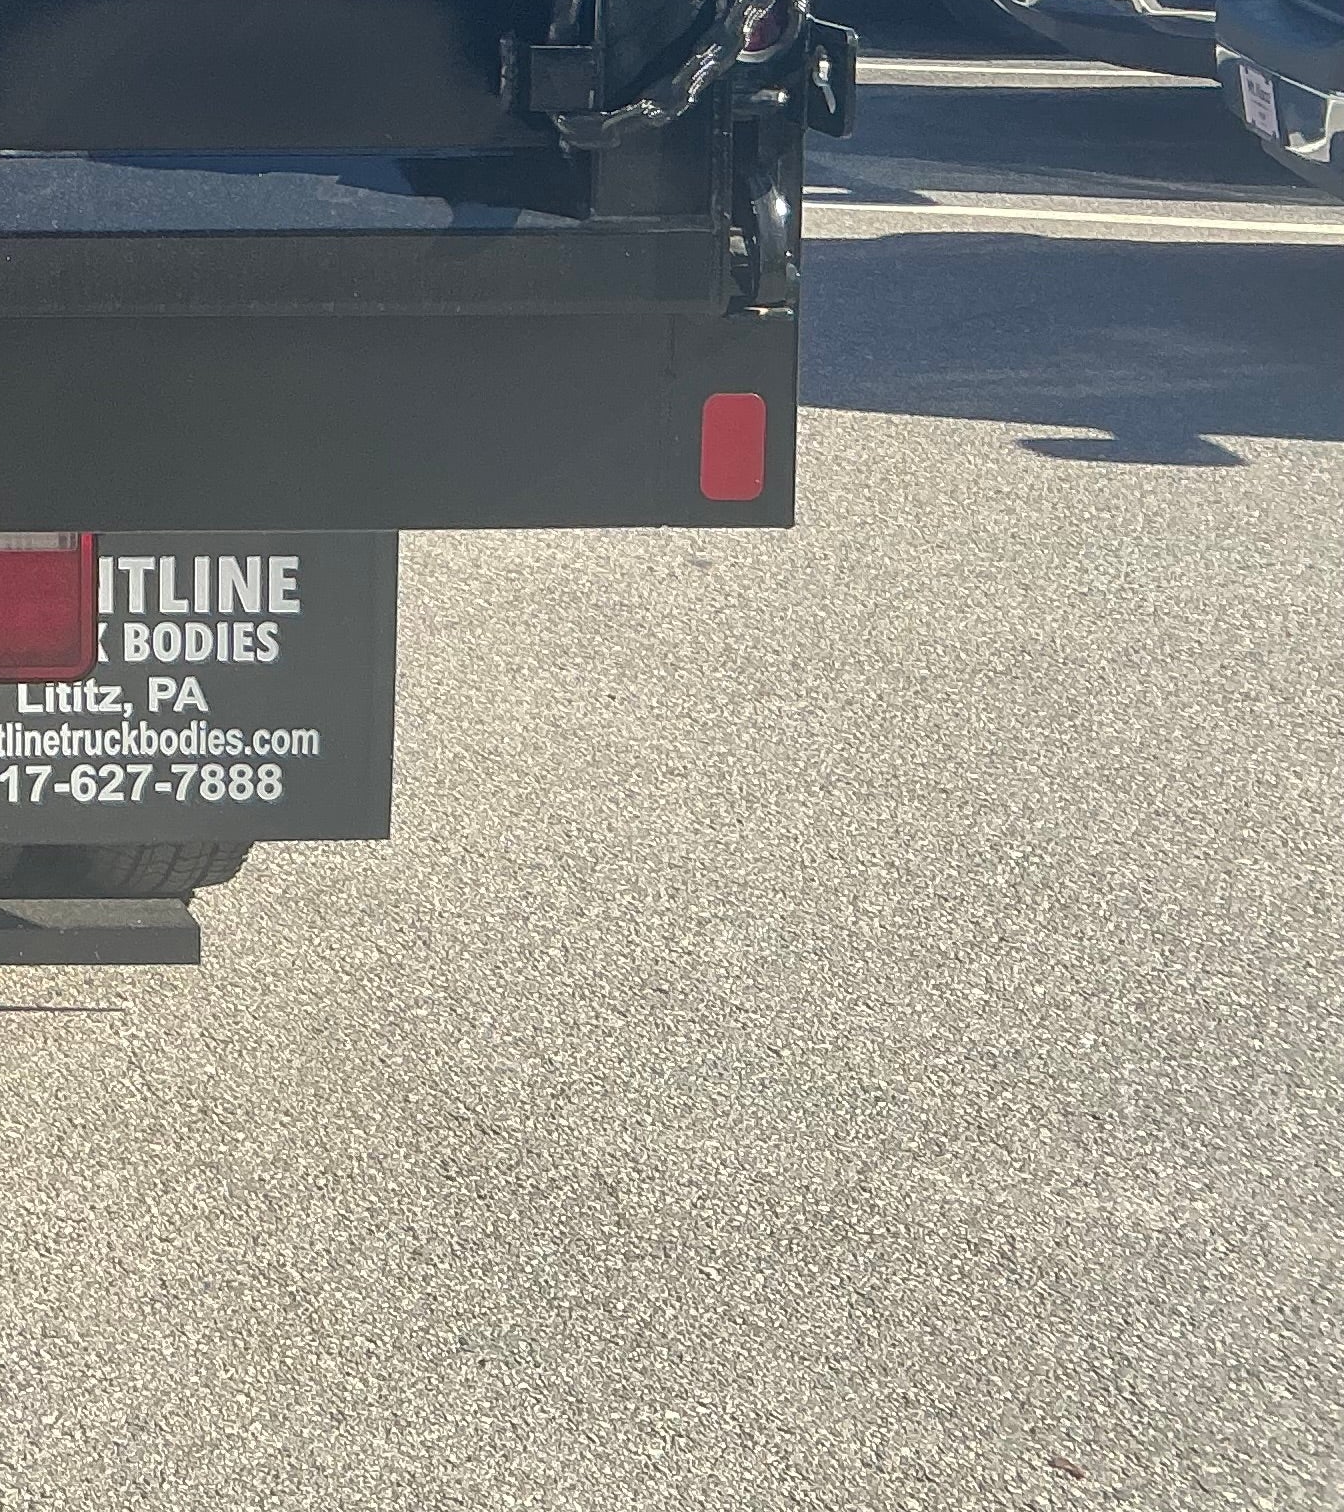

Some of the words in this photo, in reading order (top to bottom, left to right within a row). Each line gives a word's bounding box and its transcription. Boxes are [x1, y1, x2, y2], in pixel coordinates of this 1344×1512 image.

[99, 555, 301, 614] TLINE
[123, 621, 280, 663] BODIES
[17, 678, 134, 717] Lititz,
[148, 676, 209, 713] PA
